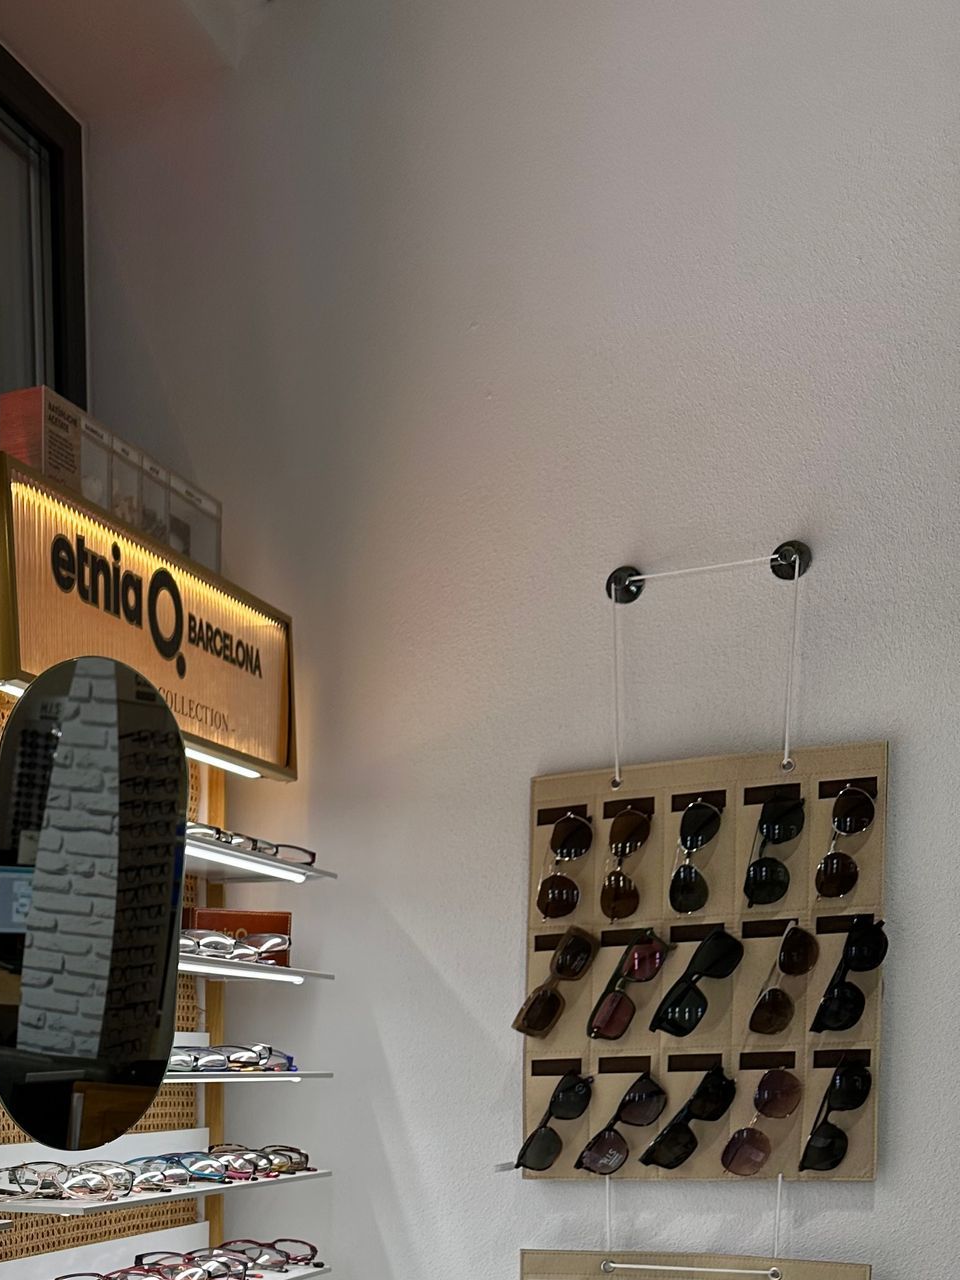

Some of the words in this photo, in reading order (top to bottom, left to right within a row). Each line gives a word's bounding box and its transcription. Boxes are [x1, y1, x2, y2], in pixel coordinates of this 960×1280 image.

[50, 533, 143, 630] etnia
[187, 613, 263, 679] BARCELONA
[158, 686, 230, 733] OLLECTION
